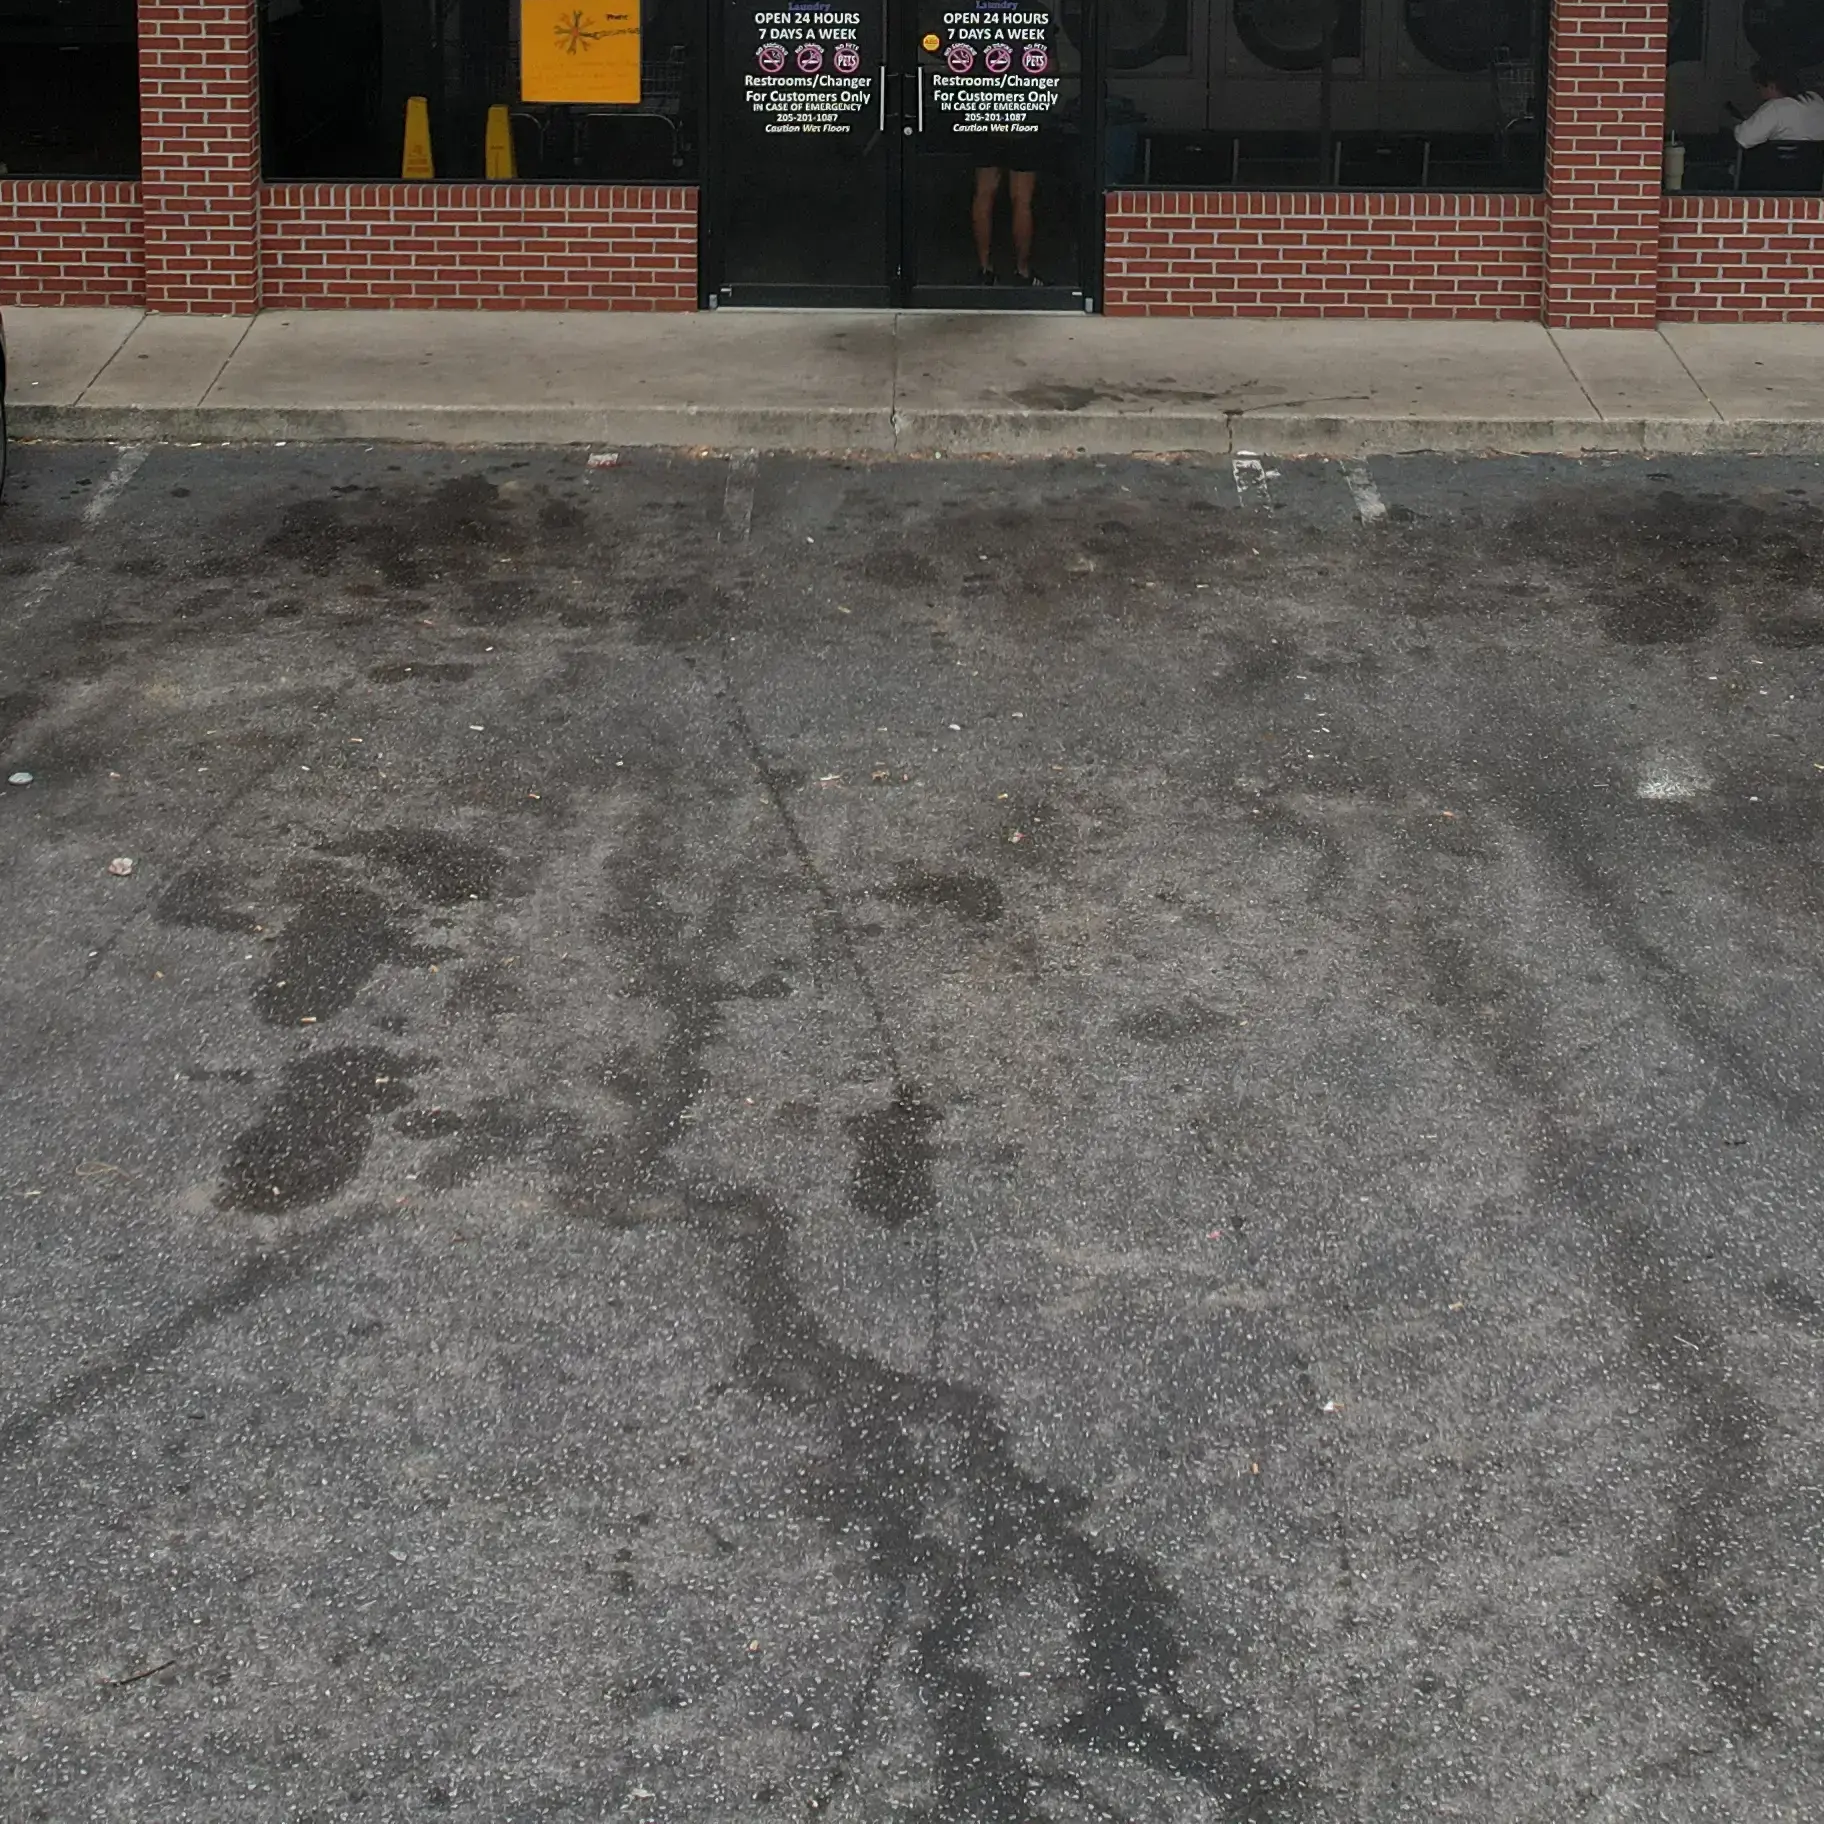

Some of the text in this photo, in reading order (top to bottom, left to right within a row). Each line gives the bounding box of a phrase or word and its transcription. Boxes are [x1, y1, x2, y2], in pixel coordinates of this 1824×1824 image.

[788, 2, 831, 12] Laundry
[976, 0, 1019, 10] Laundry
[755, 12, 860, 24] OPEN 24 HOURS
[943, 12, 1049, 24] OPEN 24 HOURS
[759, 28, 857, 40] 7 DAYS A WEEK
[948, 28, 1045, 40] 7 DAYS A WEEK
[838, 55, 856, 66] PETS
[1026, 55, 1045, 67] PETS
[745, 74, 872, 89] Restrooms/Changer
[933, 74, 1060, 89] Restrooms/Changer
[746, 91, 871, 104] For Customers Only
[934, 90, 1059, 104] For Customers Only
[753, 103, 862, 111] IN CASE OF EMERGENCY
[941, 102, 1050, 111] IN CASE OF EMERGENCY
[765, 124, 850, 132] Caution Wet Floors
[953, 124, 1039, 132] Caution Wet Floors
